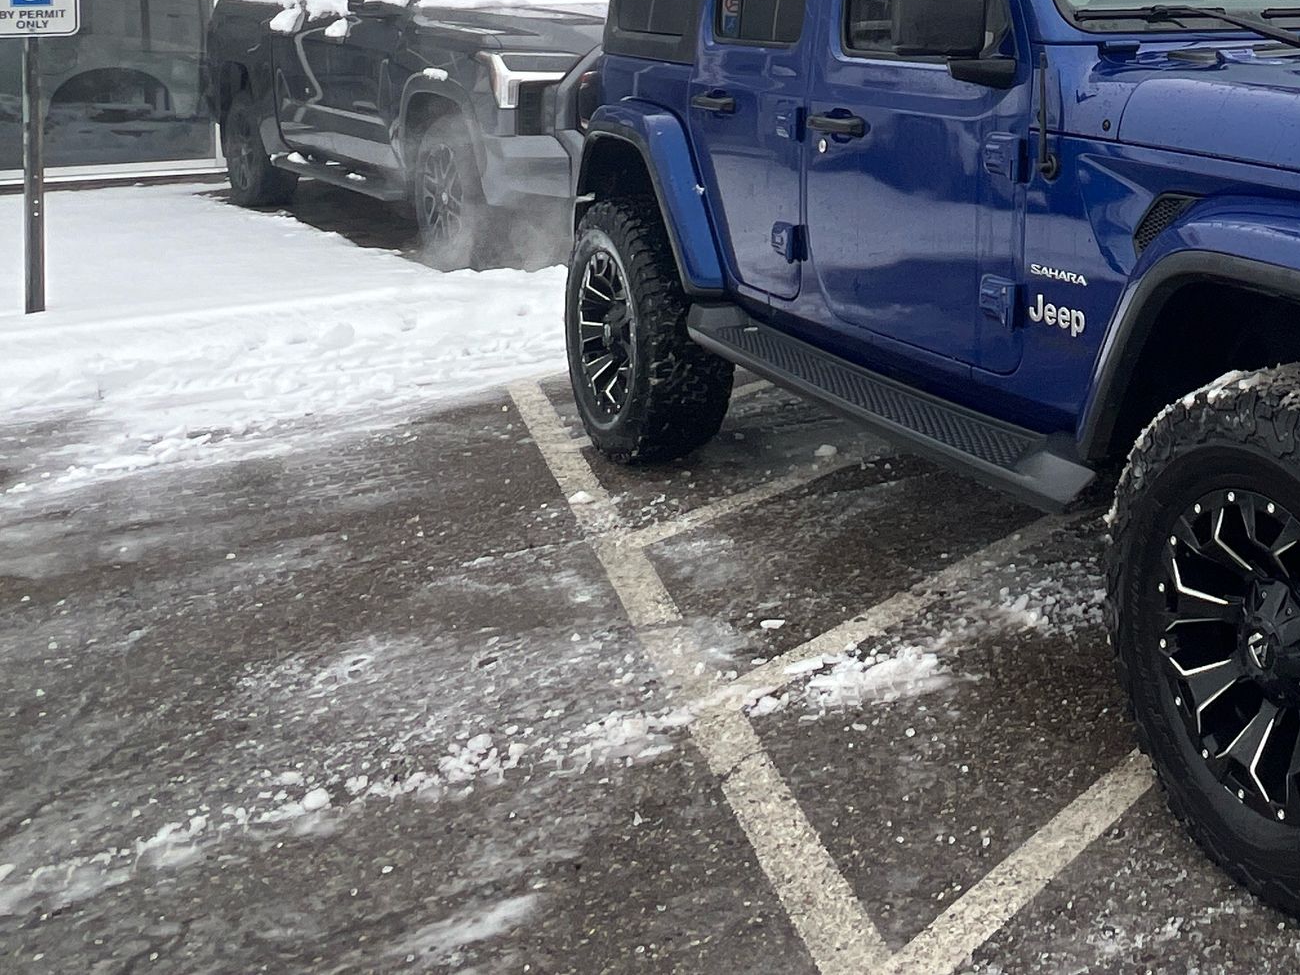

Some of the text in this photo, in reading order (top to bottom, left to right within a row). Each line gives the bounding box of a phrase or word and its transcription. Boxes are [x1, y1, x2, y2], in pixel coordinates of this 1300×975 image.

[0, 9, 66, 20] BY PERMIT
[16, 20, 49, 29] ONLY
[1030, 263, 1088, 287] SAHARA
[1029, 294, 1086, 338] Jeep
